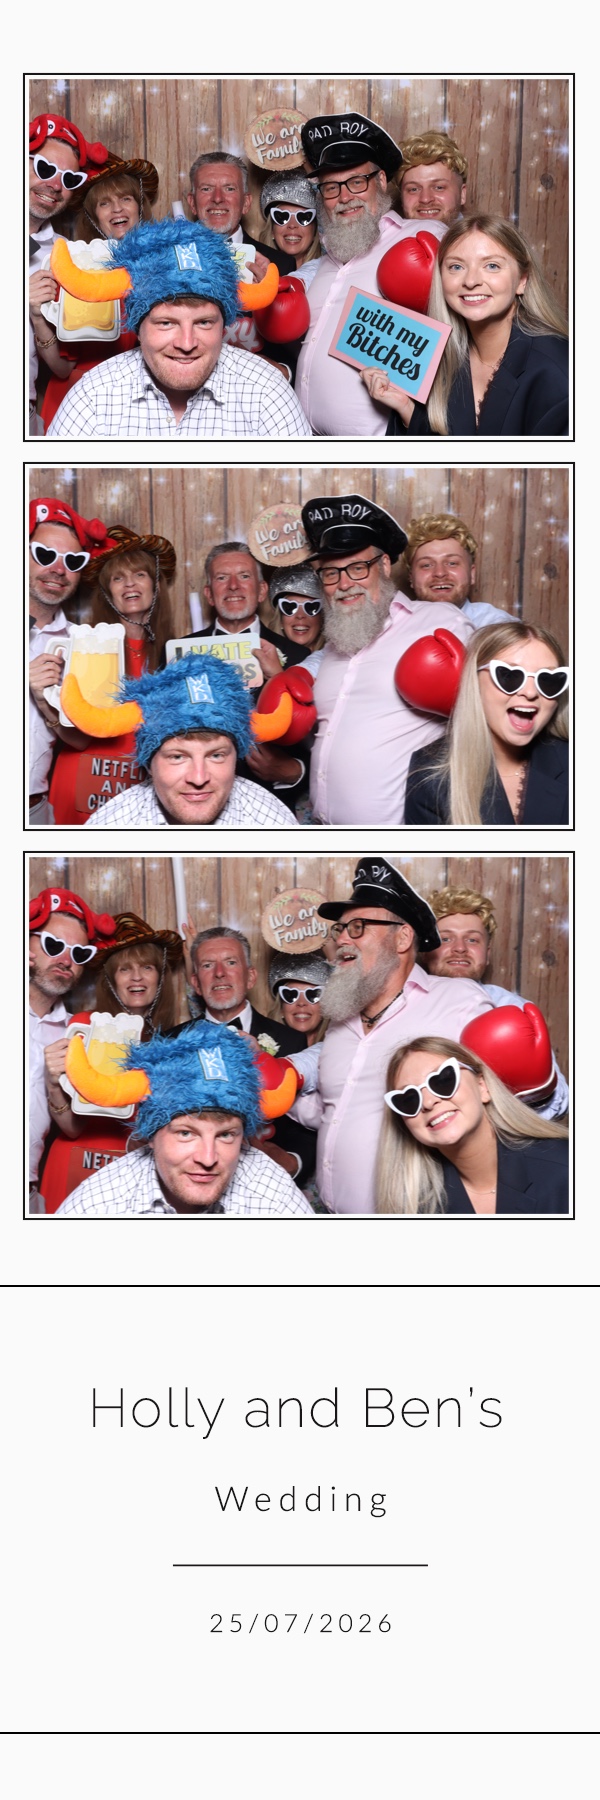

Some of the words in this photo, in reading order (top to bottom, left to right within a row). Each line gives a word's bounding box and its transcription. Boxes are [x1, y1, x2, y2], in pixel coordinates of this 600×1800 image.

[251, 126, 276, 148] We
[255, 134, 305, 165] Famil
[355, 306, 395, 336] with
[395, 327, 430, 357] my
[346, 322, 421, 381] Bitches
[255, 524, 279, 545] We
[283, 518, 304, 534] ar
[91, 757, 143, 781] NETFLI
[101, 780, 137, 794] AN
[269, 907, 295, 930] We
[298, 905, 319, 921] ar
[274, 917, 328, 946] Family
